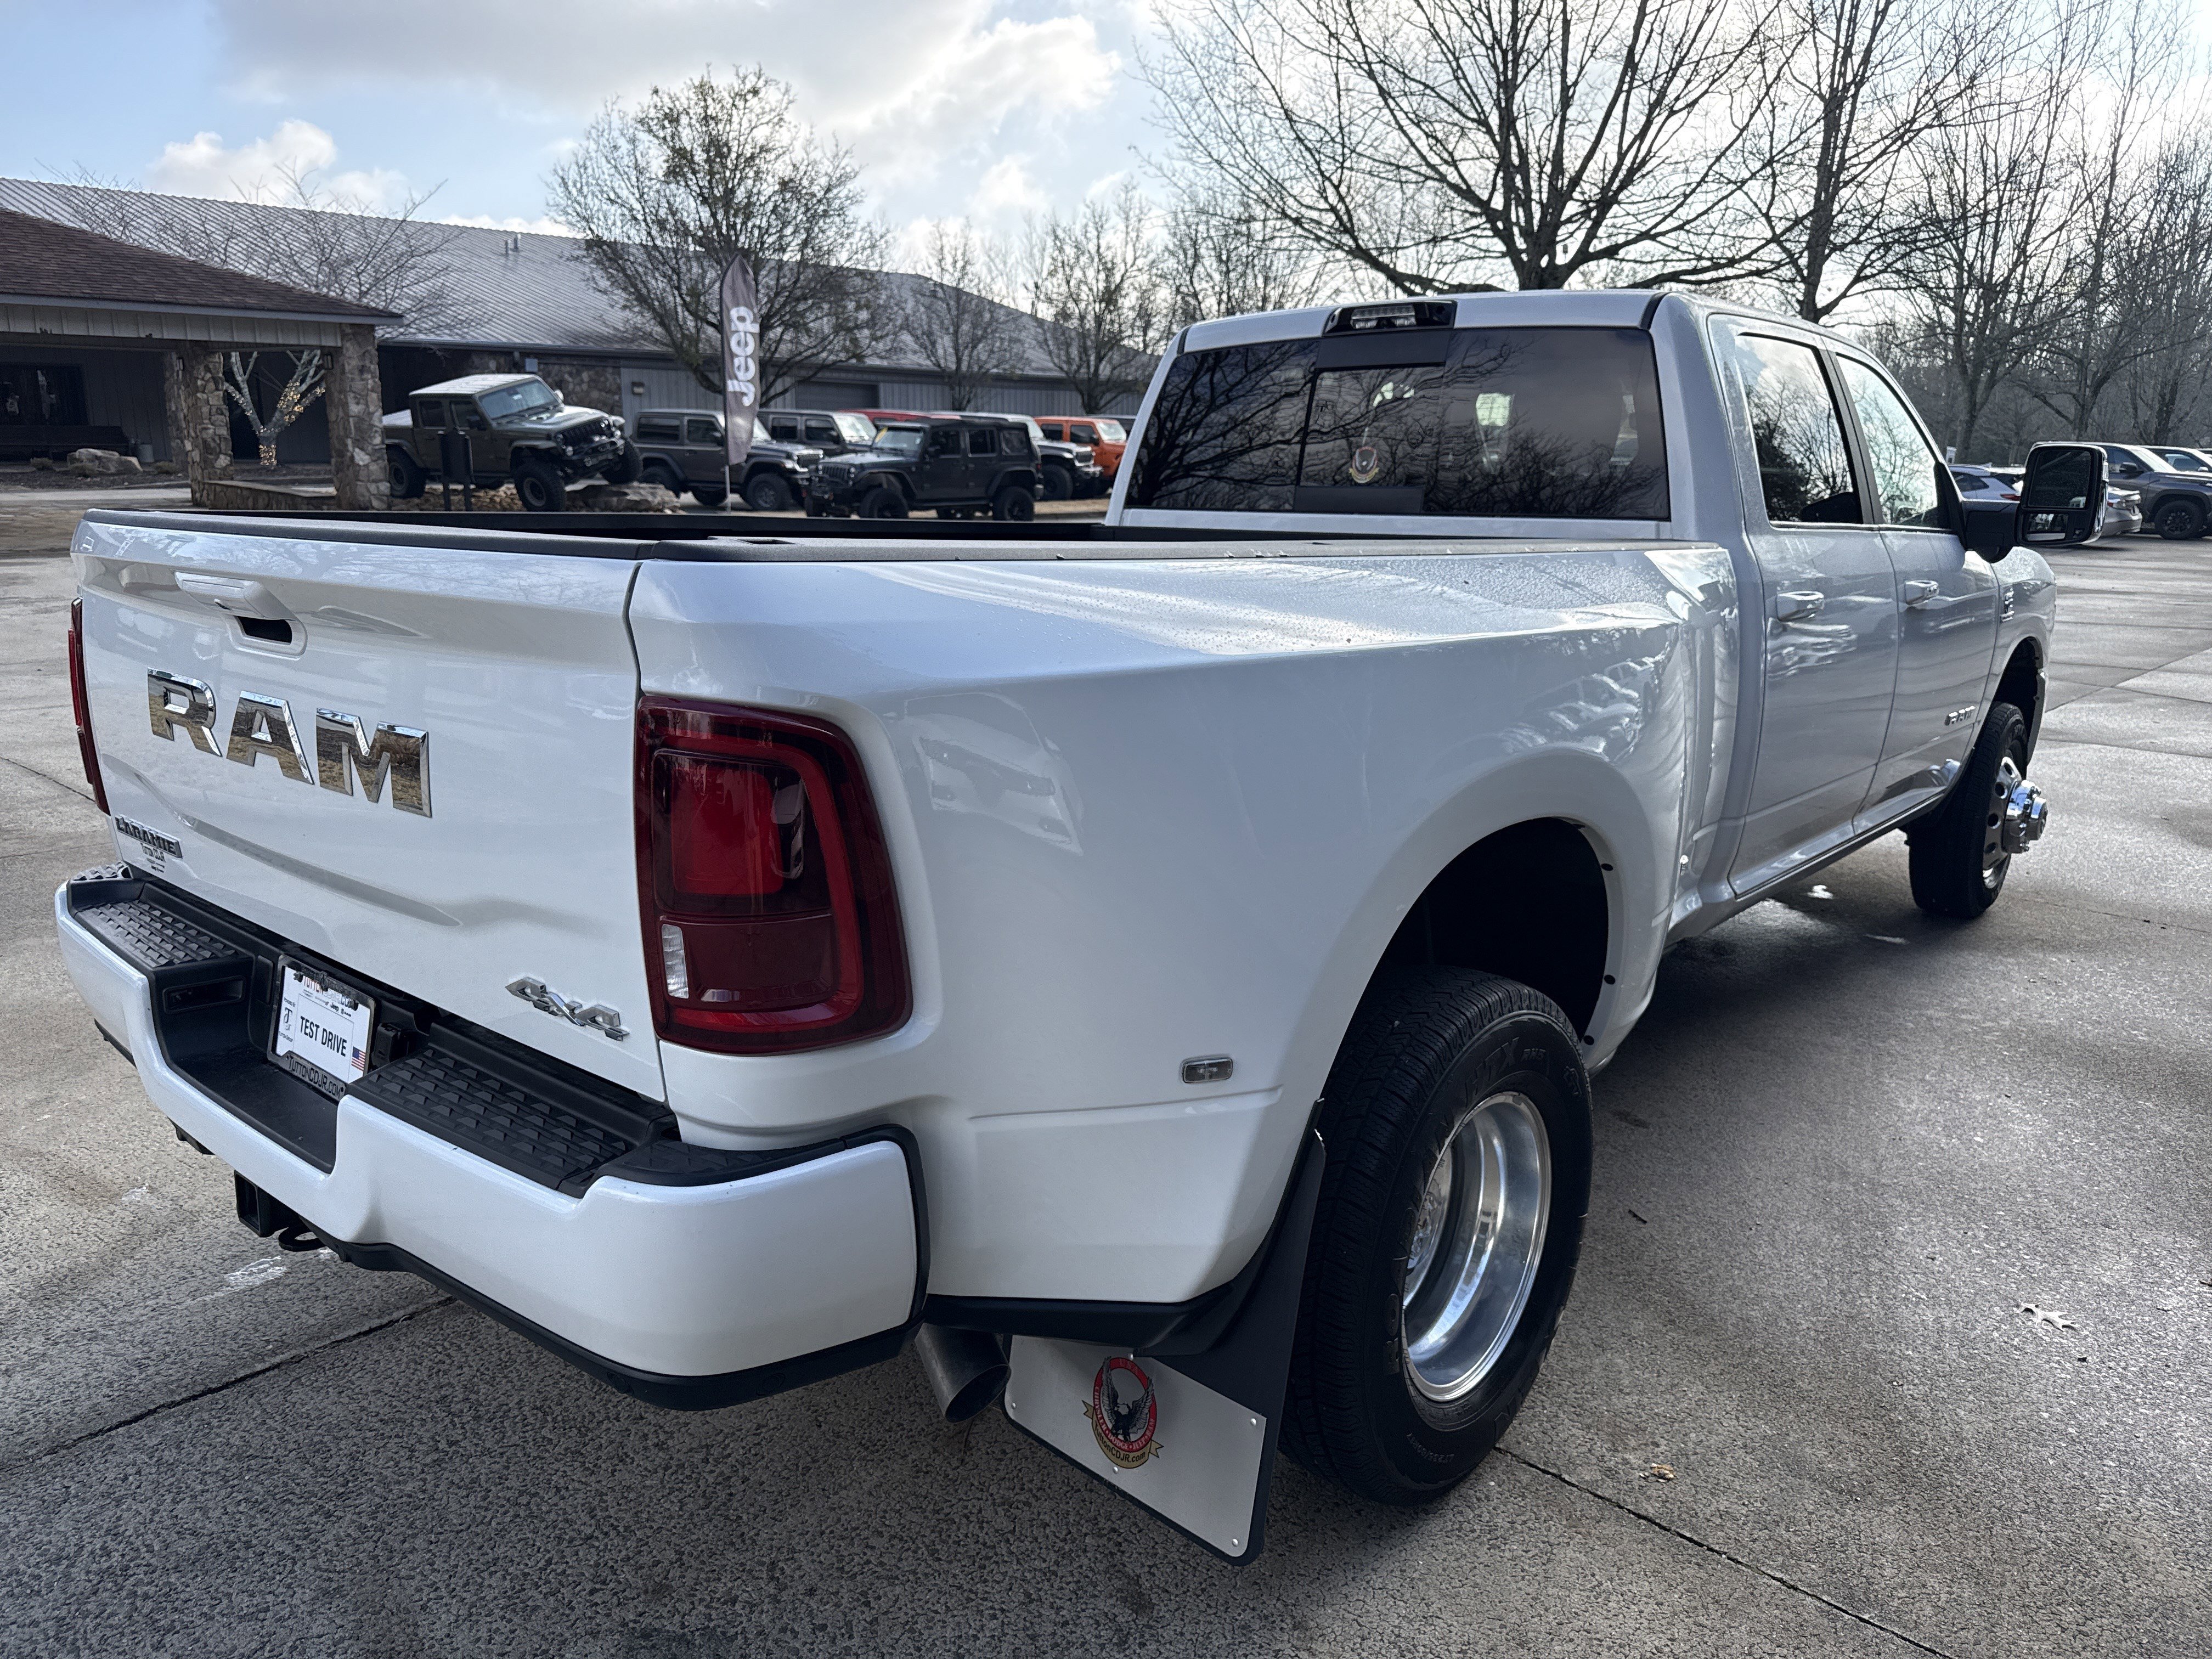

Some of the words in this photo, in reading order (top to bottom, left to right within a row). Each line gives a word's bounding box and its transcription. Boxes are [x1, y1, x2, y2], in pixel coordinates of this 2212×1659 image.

[727, 306, 760, 407] Jeep
[147, 667, 432, 819] RAM
[115, 816, 178, 856] LARAMIE
[300, 1015, 320, 1041] TEST
[321, 1028, 347, 1057] DRIVE
[1094, 1386, 1107, 1432] CHRYSLER
[1107, 1431, 1129, 1449] DODGE
[1132, 1437, 1147, 1449] JEEP
[1094, 1421, 1146, 1463] TuttonCDJR.com
